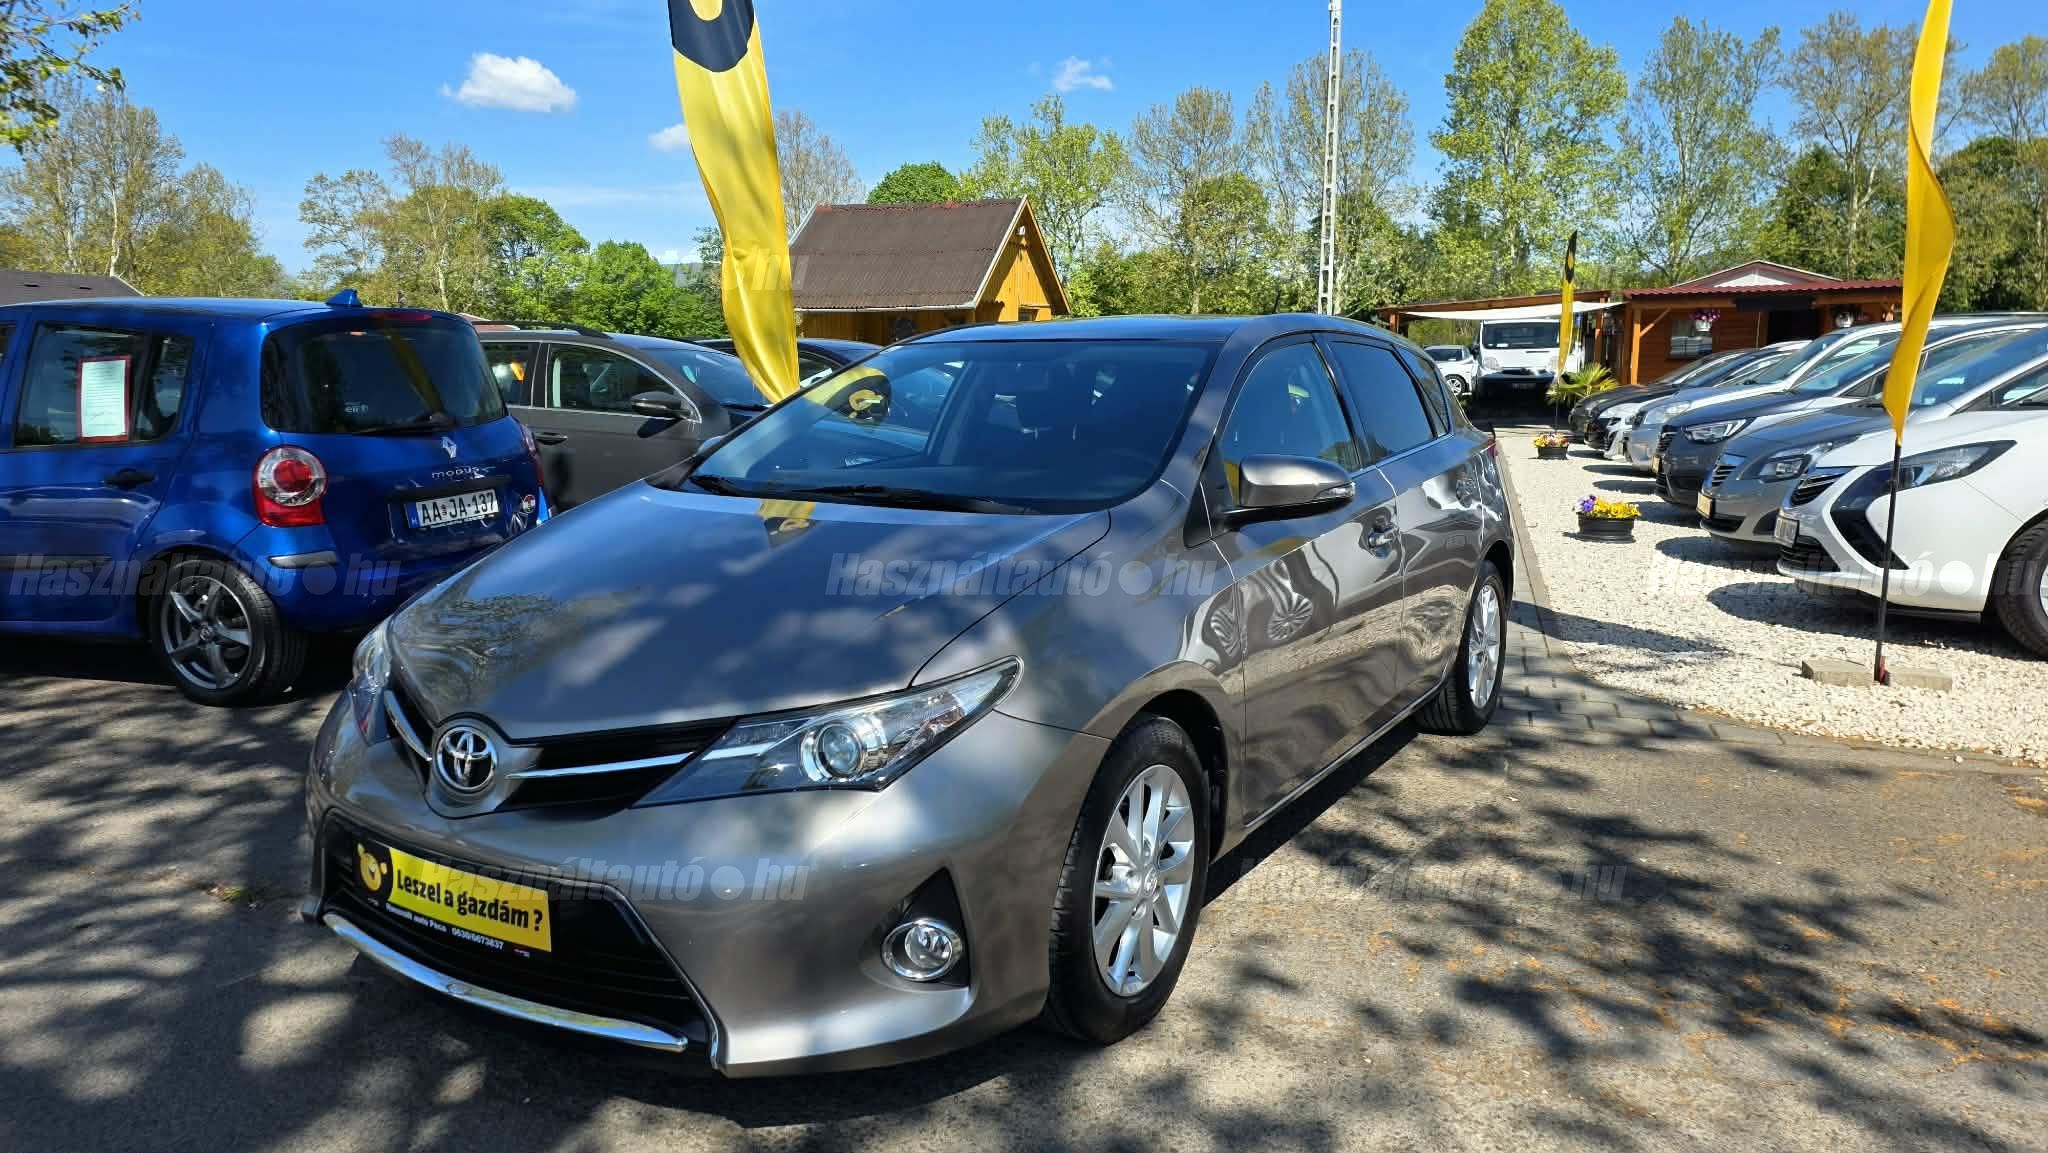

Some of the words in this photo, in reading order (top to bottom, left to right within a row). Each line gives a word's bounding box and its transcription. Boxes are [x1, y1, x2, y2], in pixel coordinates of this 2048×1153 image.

[397, 869, 441, 904] Leszel
[445, 890, 454, 907] a
[457, 891, 530, 930] gazdám
